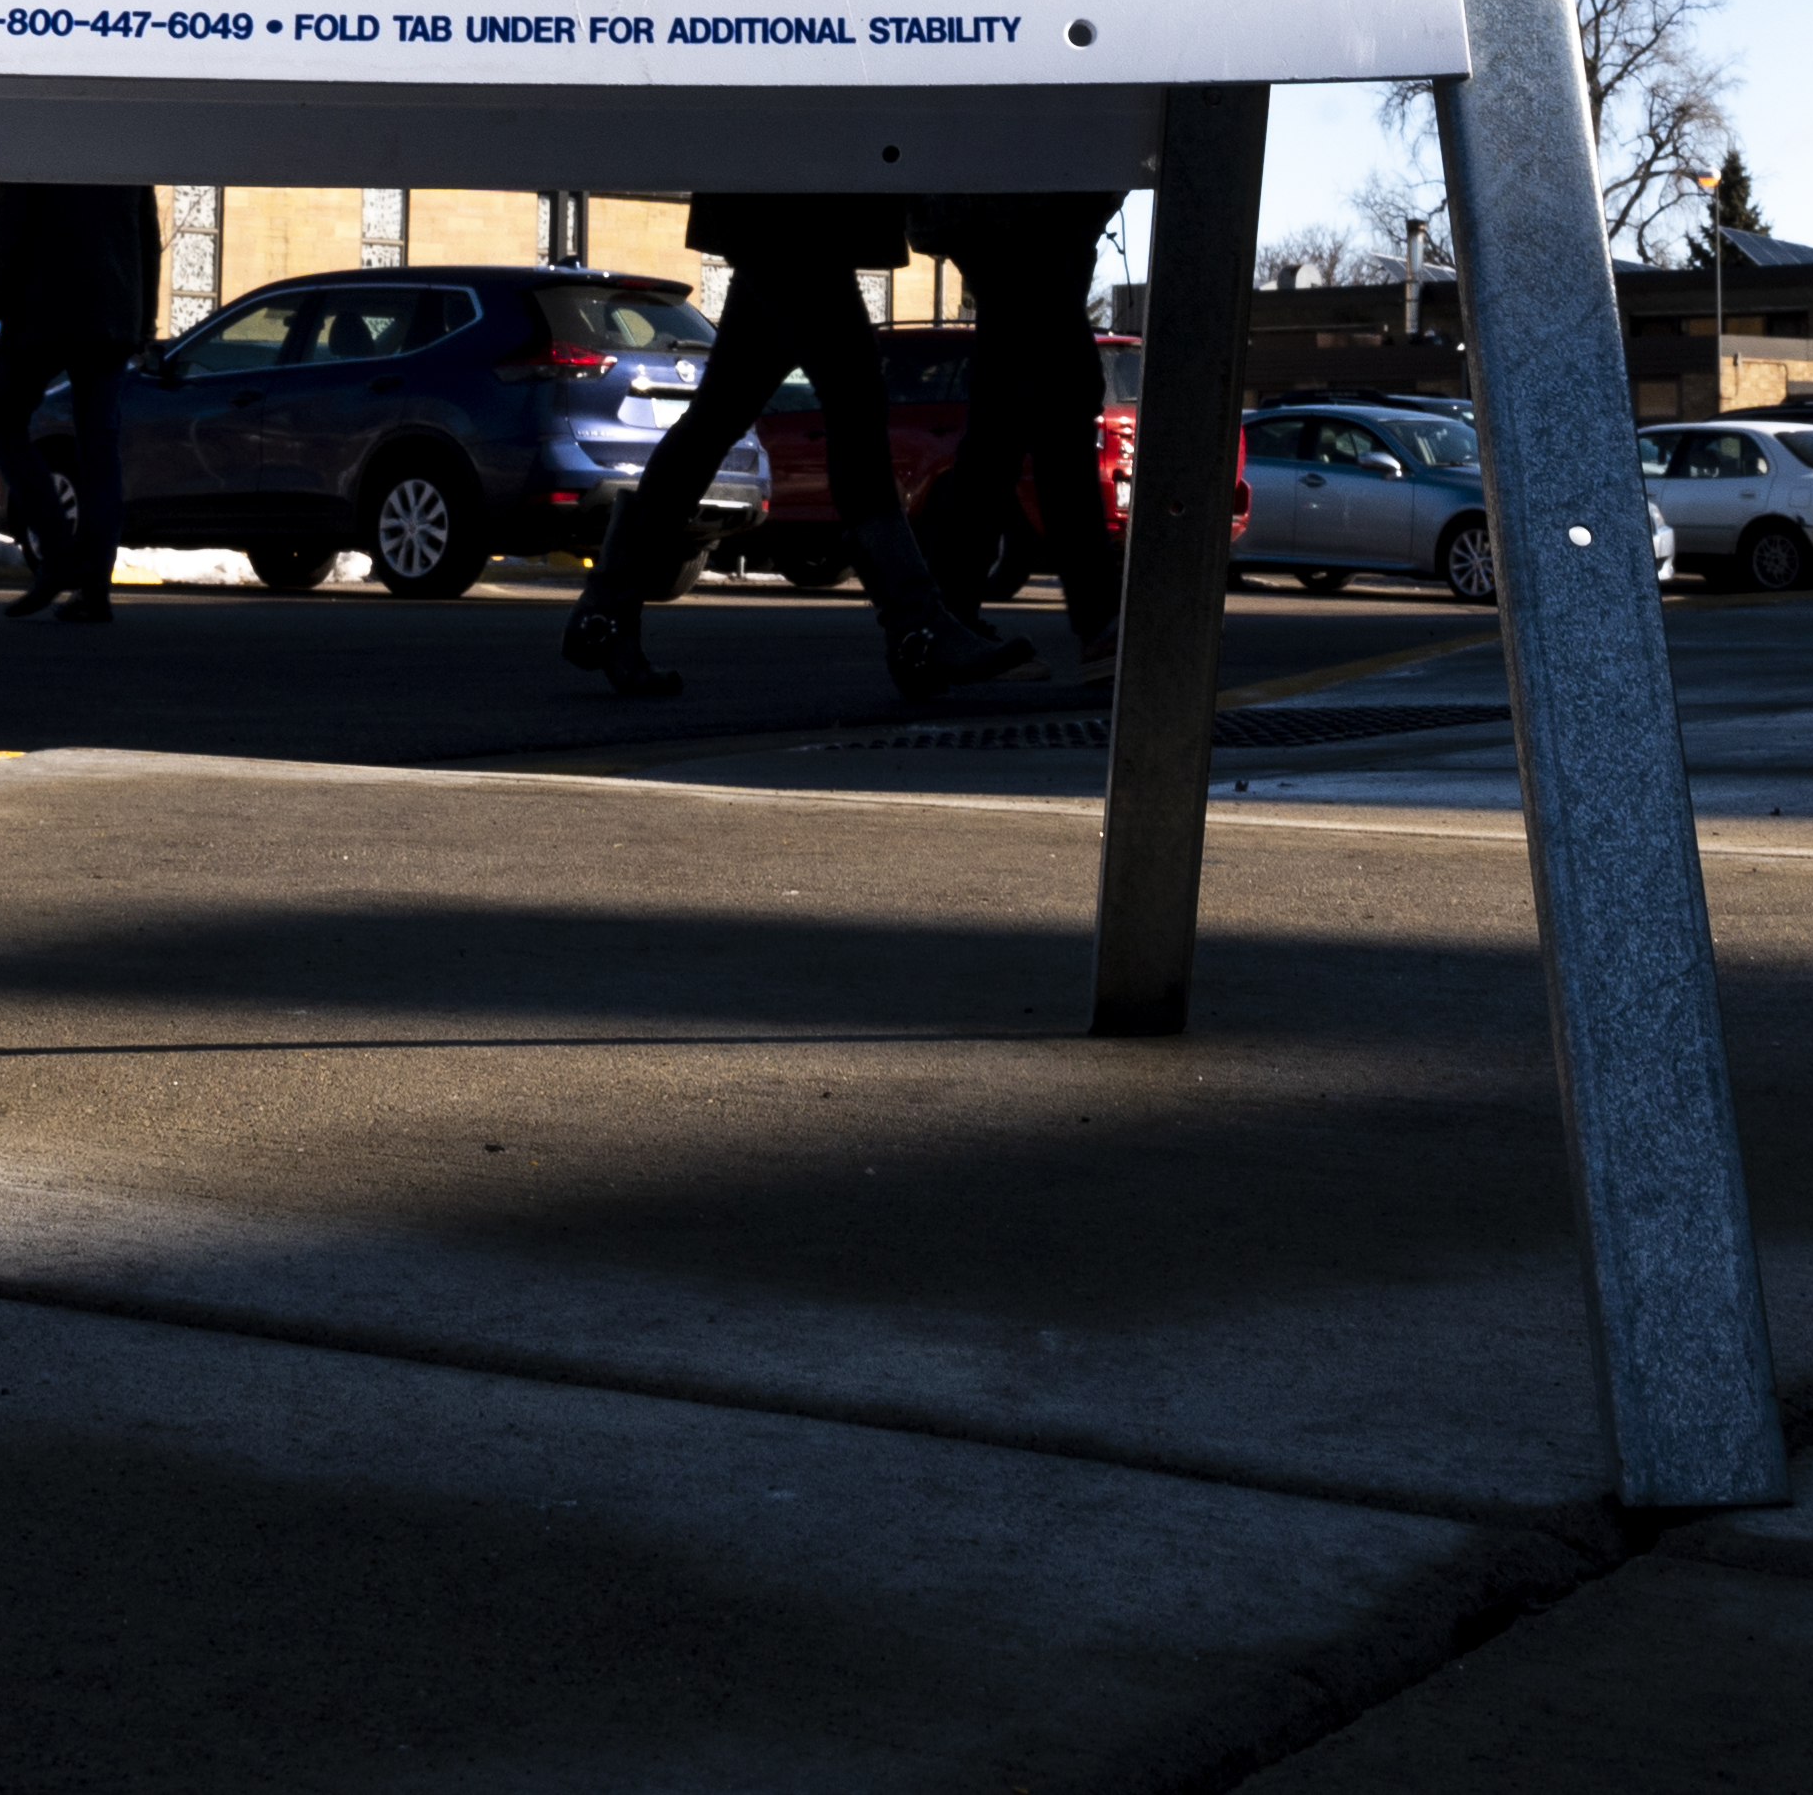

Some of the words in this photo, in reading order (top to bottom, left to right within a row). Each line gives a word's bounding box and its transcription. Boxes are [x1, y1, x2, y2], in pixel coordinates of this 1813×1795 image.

[294, 13, 380, 42] FOLD
[392, 15, 453, 43] TAB
[466, 16, 576, 44] UNDER
[589, 16, 654, 44] FOR
[667, 17, 857, 45] ADDITIONAL
[868, 16, 1022, 45] STABILITY
